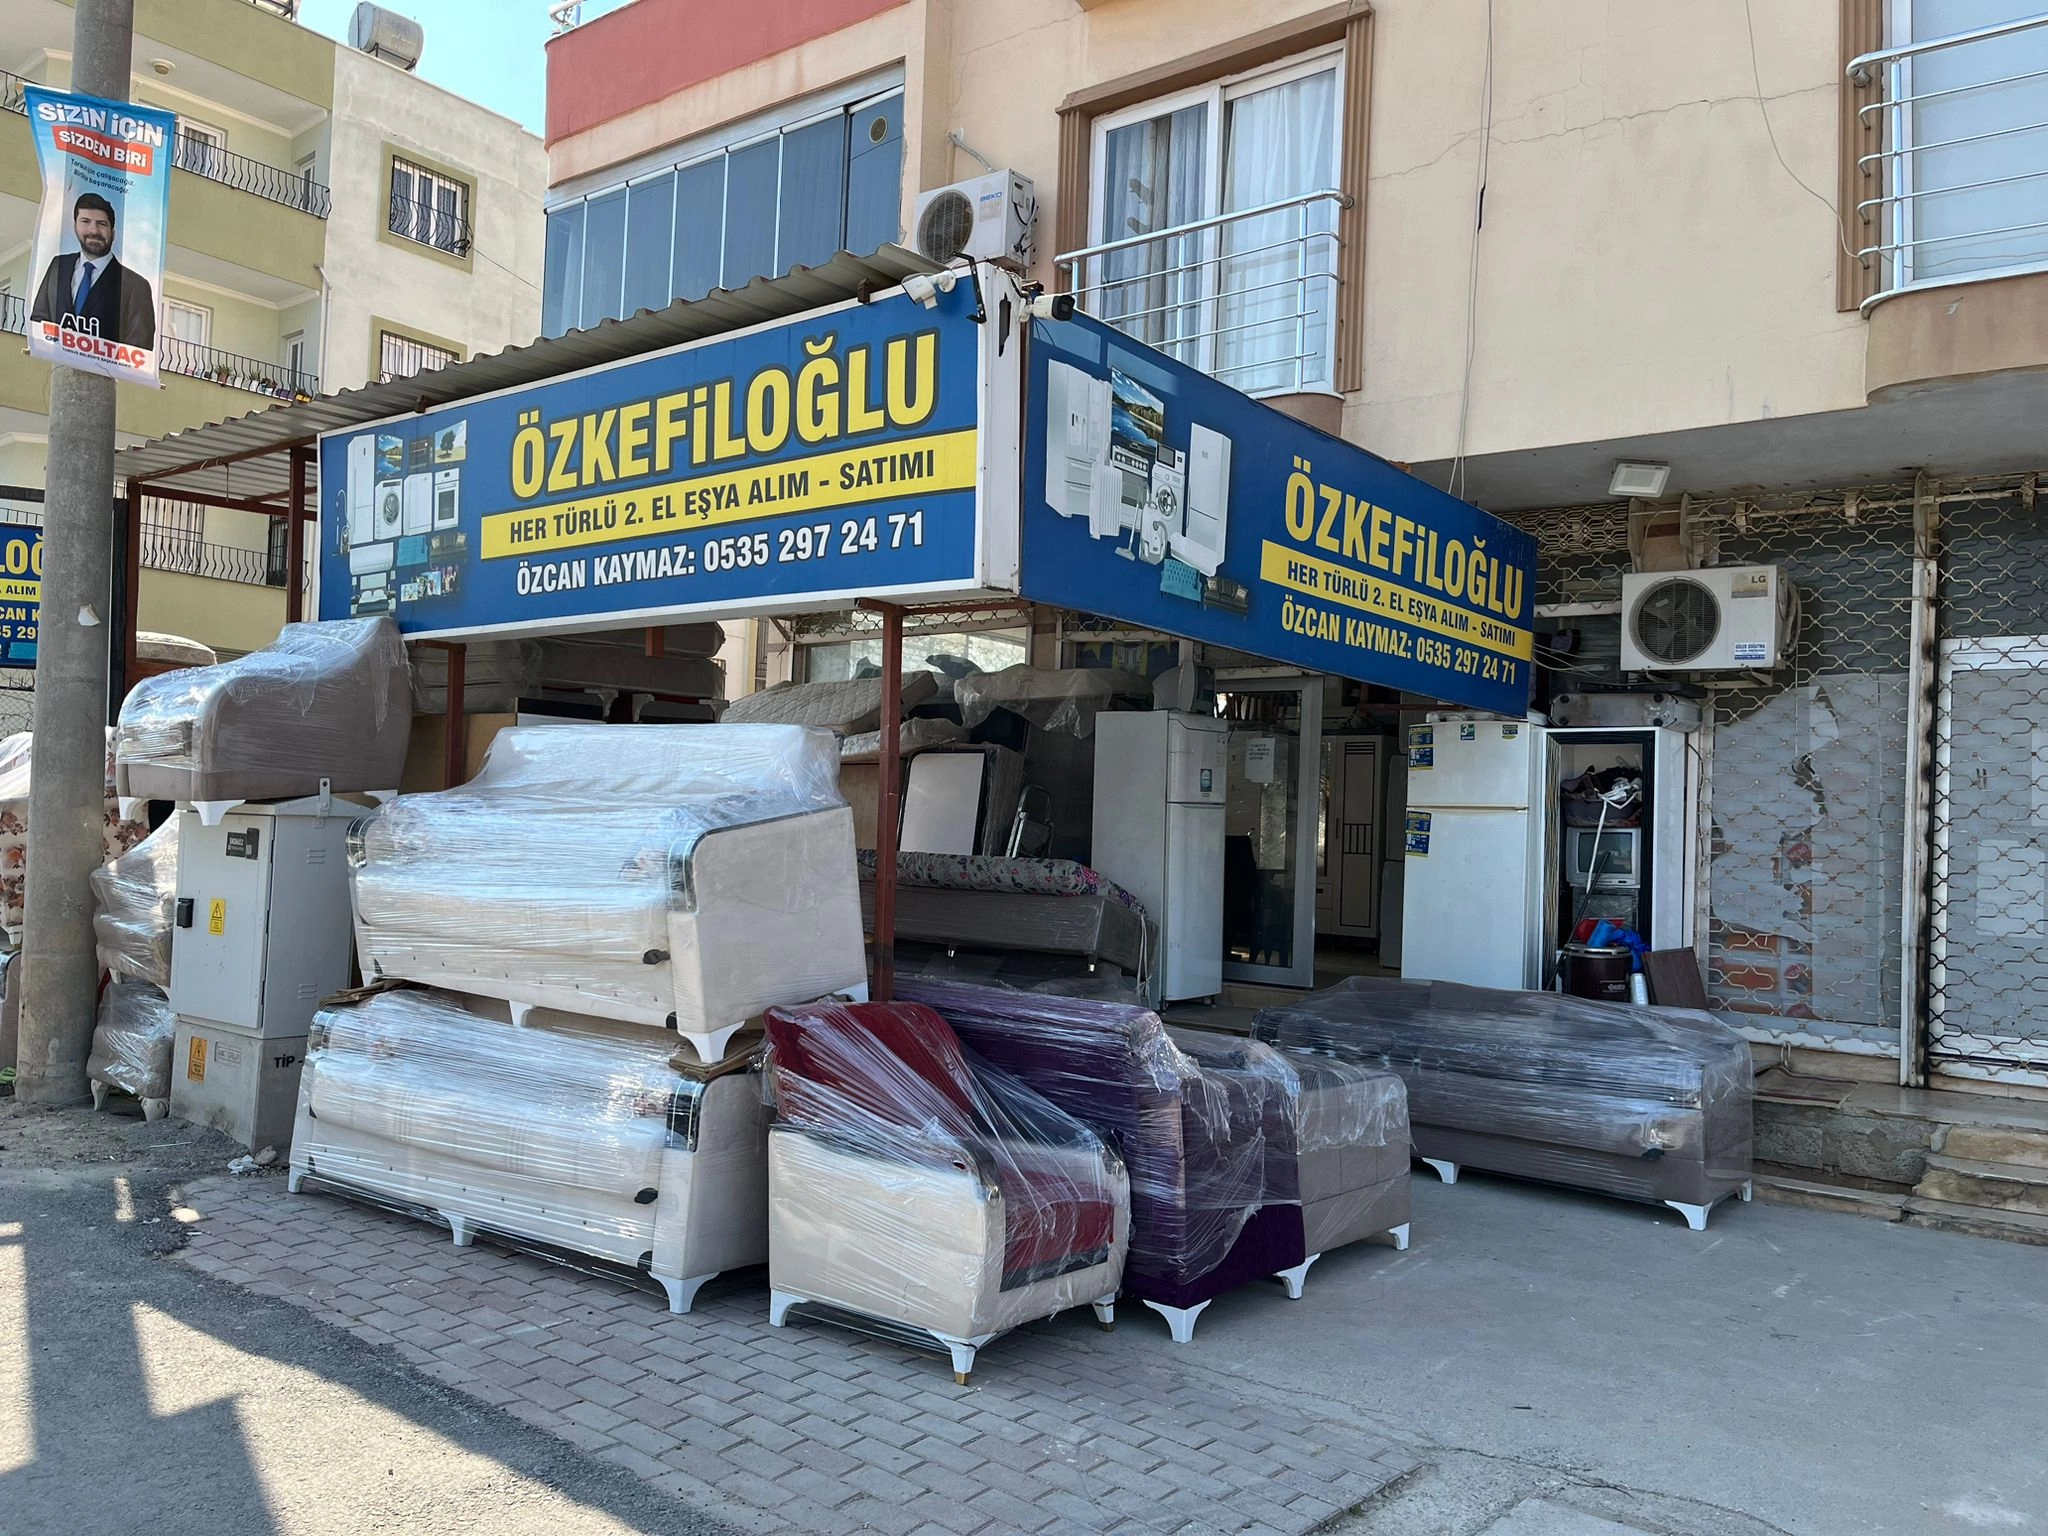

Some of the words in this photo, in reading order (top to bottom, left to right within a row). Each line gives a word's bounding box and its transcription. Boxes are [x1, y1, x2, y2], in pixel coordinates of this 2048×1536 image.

[980, 191, 1003, 202] BEKO
[62, 331, 146, 369] BOLTAÇ
[510, 517, 547, 544] HER
[553, 500, 617, 537] TÜRLÜ
[625, 501, 644, 526] 2.
[652, 495, 677, 521] EL
[685, 484, 740, 520] EŞYA
[748, 470, 809, 505] ALIM
[840, 450, 934, 490] SATIMI
[517, 559, 586, 595] ÖZCAN
[594, 545, 695, 586] KAYMAZ:
[704, 533, 769, 572] 0535
[778, 524, 831, 562] 297
[840, 518, 878, 554] 24
[888, 511, 923, 548] 71
[1751, 575, 1767, 584] LG
[6, 584, 37, 596] ALIM
[1288, 560, 1318, 588] HER
[1323, 570, 1368, 601] TÜRLÜ
[1373, 587, 1385, 607] 2.
[1389, 592, 1404, 612] EL
[1408, 598, 1437, 622] EŞYA
[1441, 609, 1468, 632] ALIM
[1480, 621, 1515, 646] SATIMI
[1281, 594, 1340, 642] ÖZCAN
[1345, 617, 1412, 659] KAYMAZ:
[1416, 636, 1450, 669] 0535
[1454, 647, 1479, 675] 297
[1482, 655, 1498, 680] 24
[1502, 660, 1516, 685] 71
